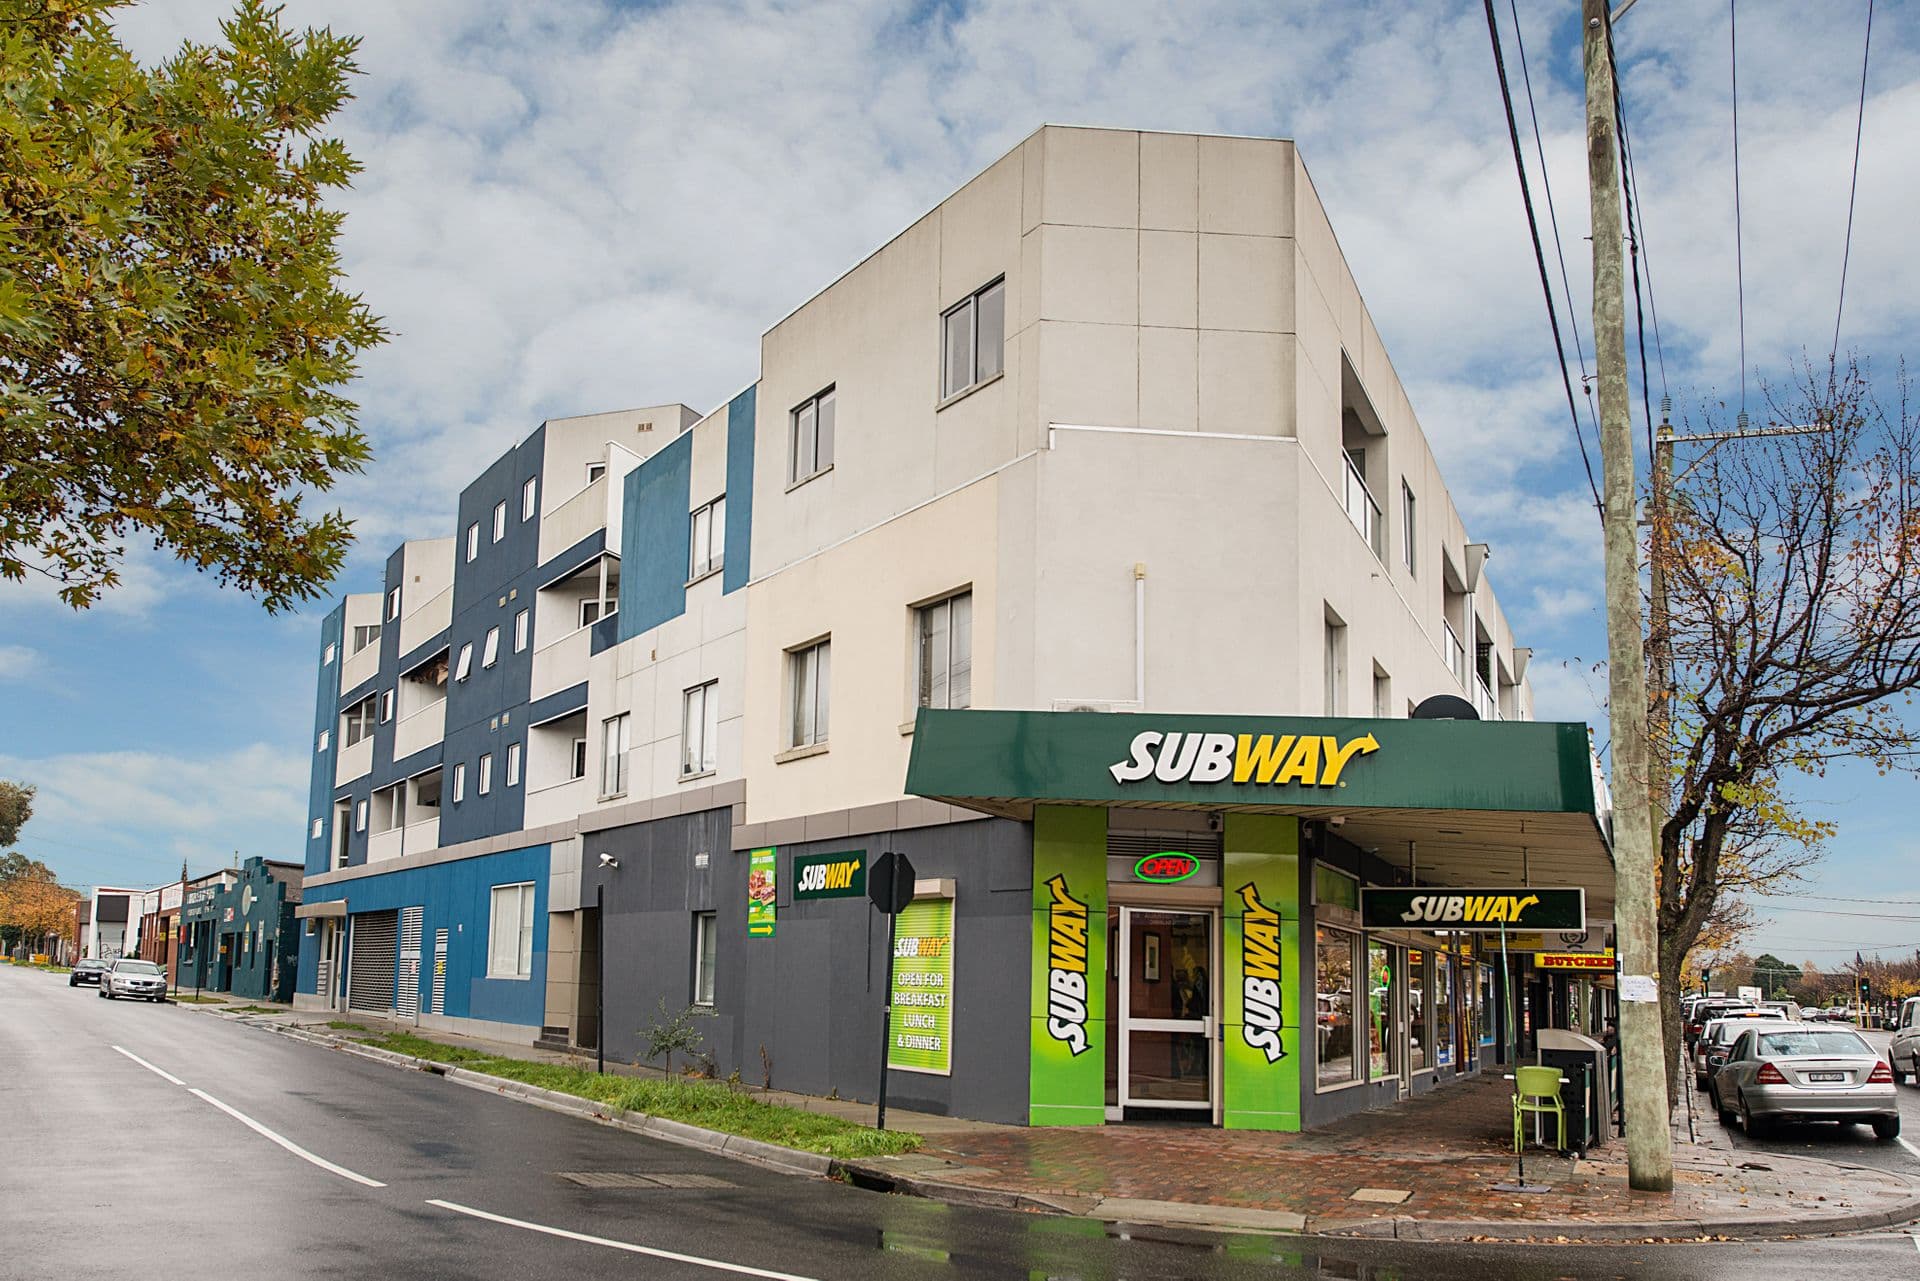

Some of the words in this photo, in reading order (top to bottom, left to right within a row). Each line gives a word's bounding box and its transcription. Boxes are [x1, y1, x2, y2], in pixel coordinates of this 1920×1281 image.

[1109, 731, 1380, 788] SUBWAY
[799, 859, 859, 892] SUBWAY
[1143, 858, 1191, 875] OPEN
[1400, 894, 1539, 923] SUBWAY
[894, 934, 949, 957] SUBWAY
[1044, 873, 1093, 1057] SUBWAY
[1235, 882, 1288, 1064] SUBWAY
[897, 972, 922, 987] OPEN
[924, 972, 944, 988] FOR
[894, 991, 947, 1008] BREAKFAST
[903, 1013, 936, 1029] LUNCH
[896, 1033, 905, 1049] &
[905, 1034, 942, 1052] DINNER
